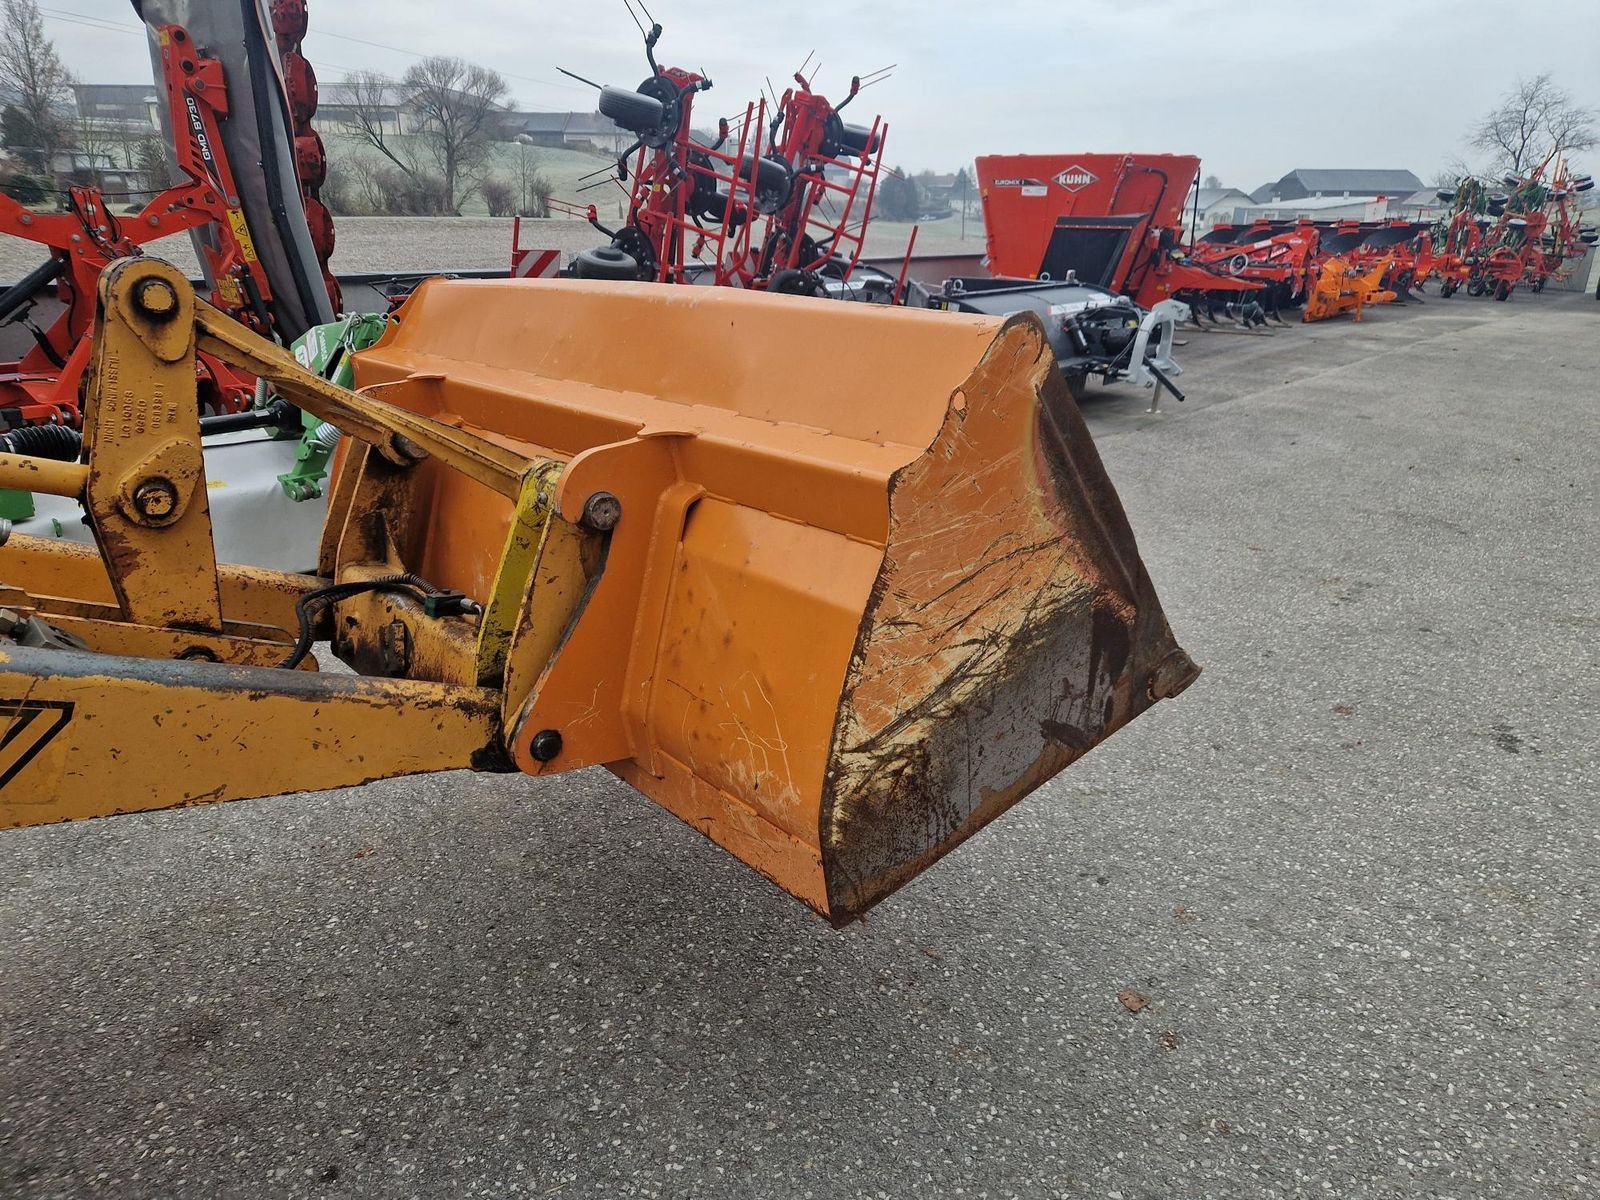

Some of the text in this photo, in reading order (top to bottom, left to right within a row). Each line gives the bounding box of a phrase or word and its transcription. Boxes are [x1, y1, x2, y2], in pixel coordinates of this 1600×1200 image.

[186, 97, 211, 160] GMD 8730
[1058, 174, 1091, 184] KUHN
